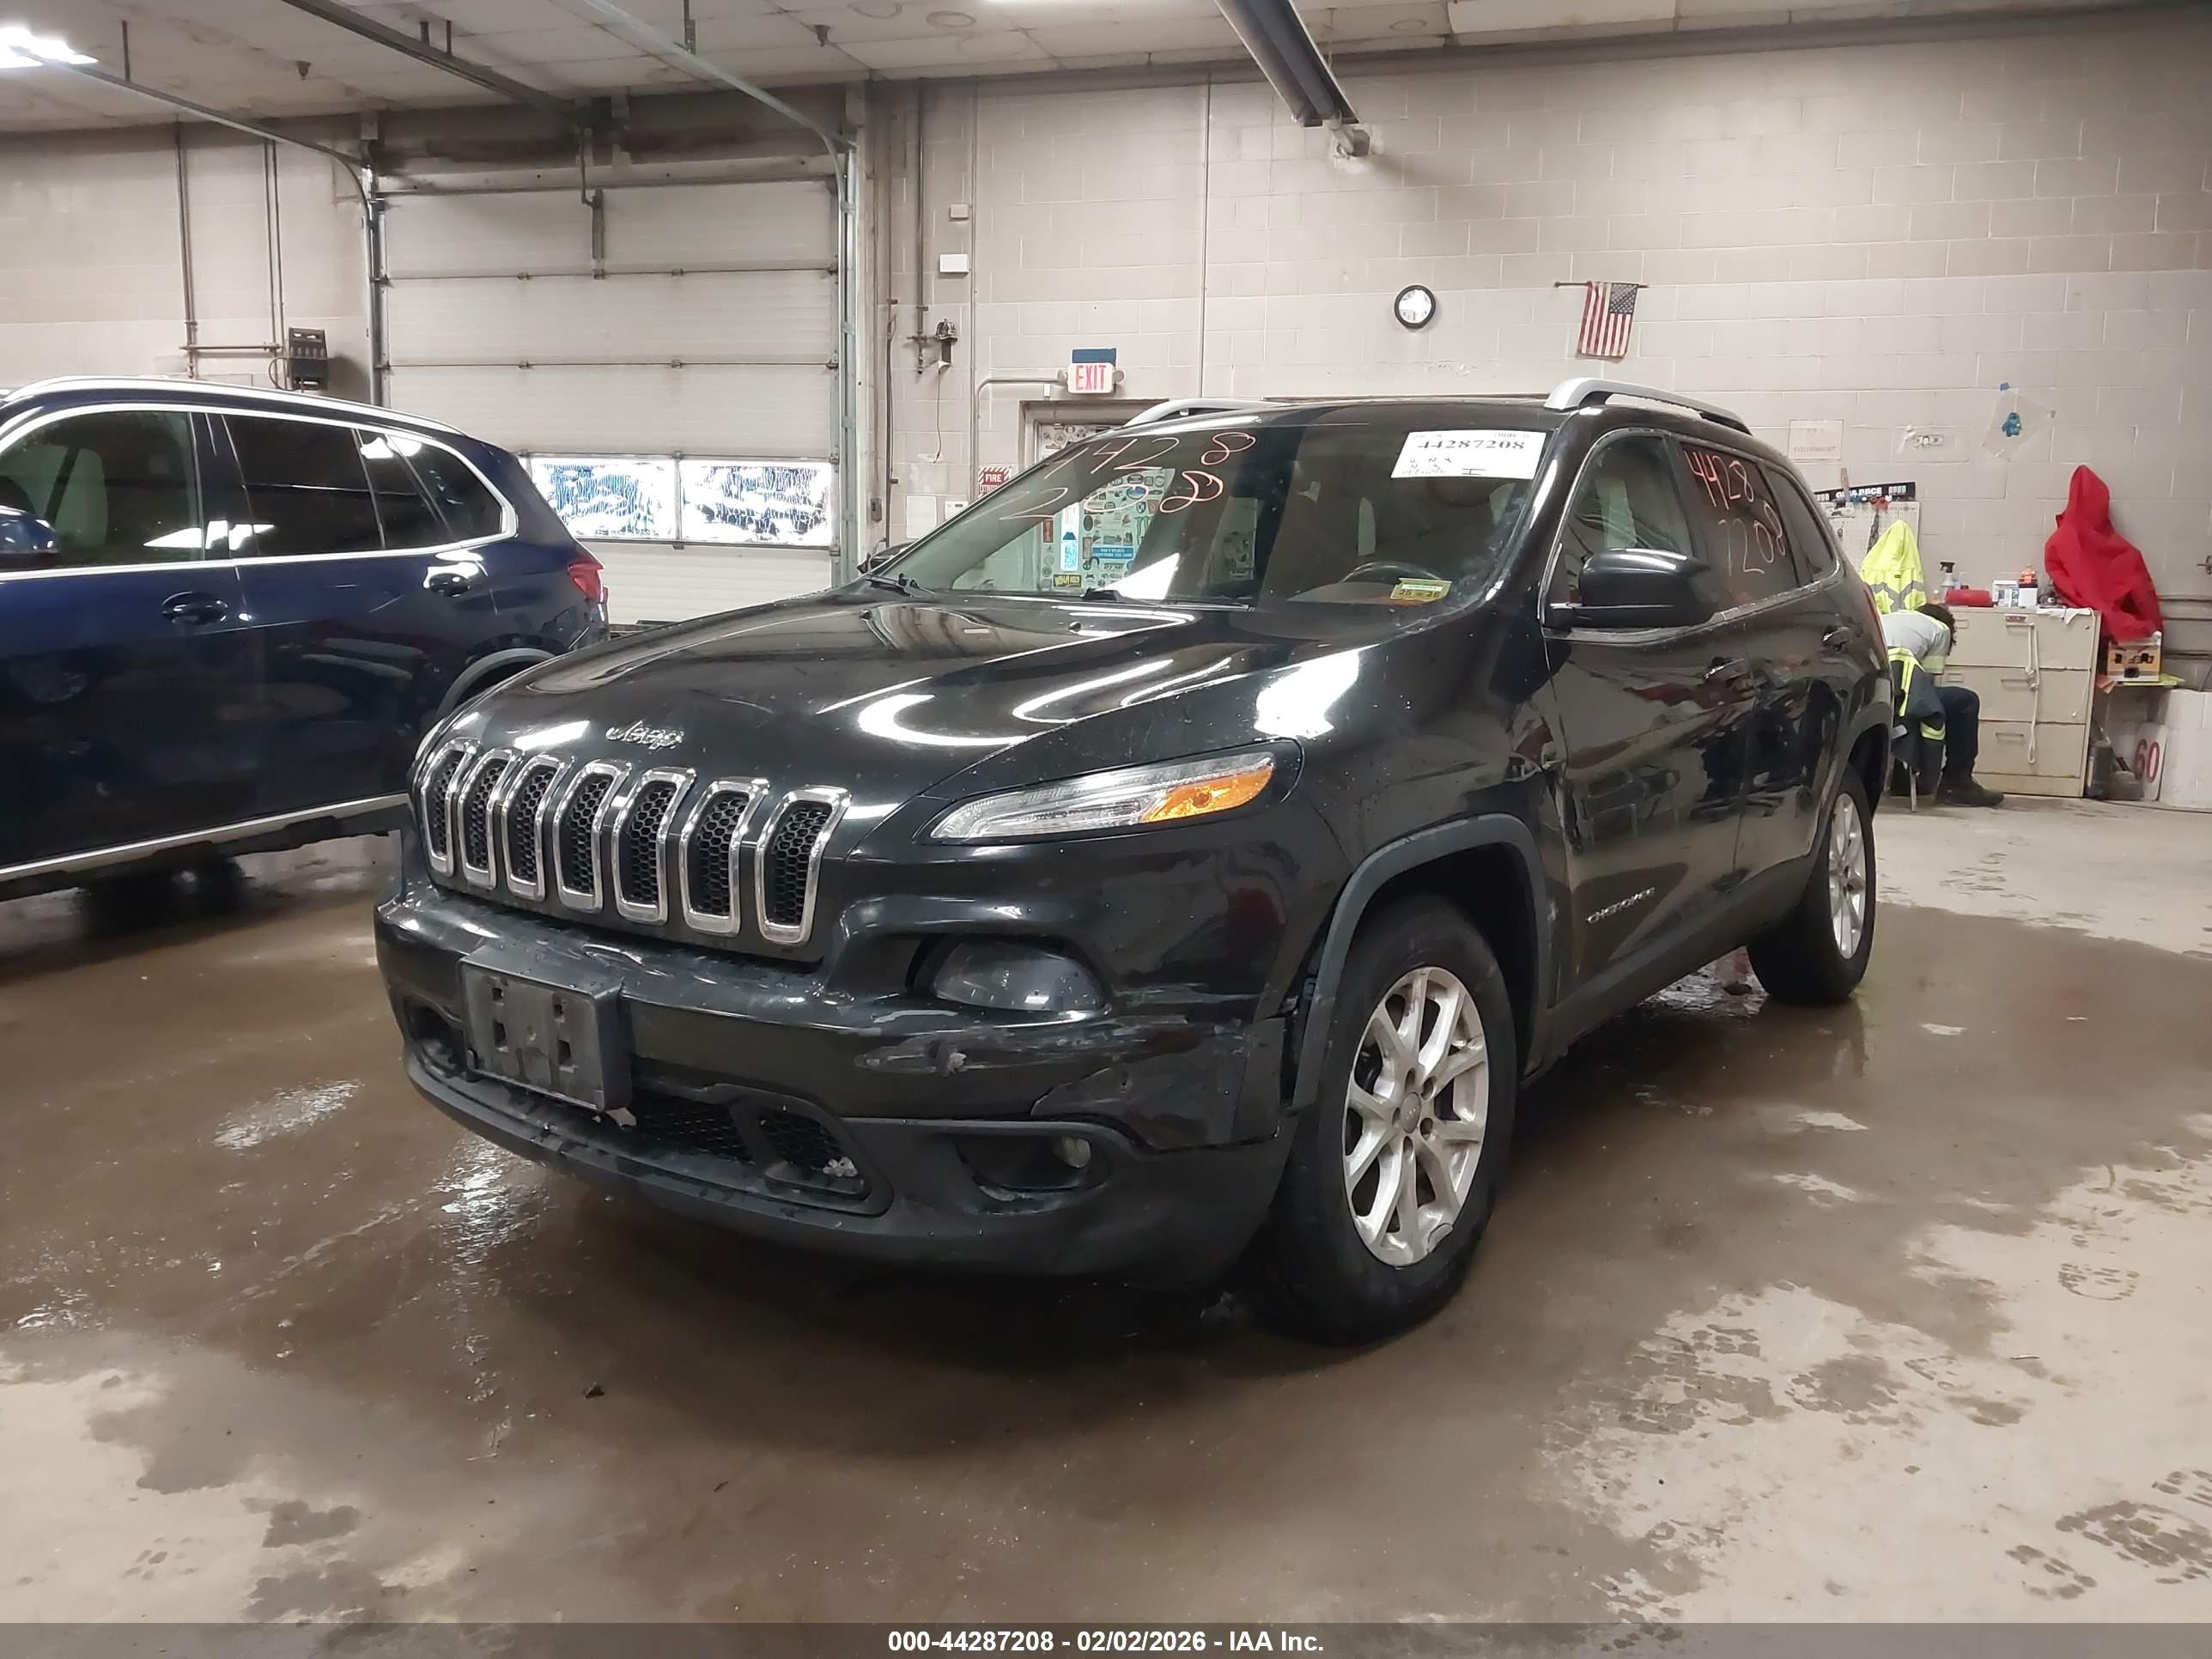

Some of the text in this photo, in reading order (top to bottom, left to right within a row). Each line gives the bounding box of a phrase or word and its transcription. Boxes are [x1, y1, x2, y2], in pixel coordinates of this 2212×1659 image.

[1076, 365, 1106, 390] EXIT
[1418, 440, 1525, 449] 44287208
[985, 473, 1002, 483] FIRE
[1684, 450, 1754, 510] 4428
[1718, 500, 1786, 577] 7208
[2135, 738, 2160, 784] 60
